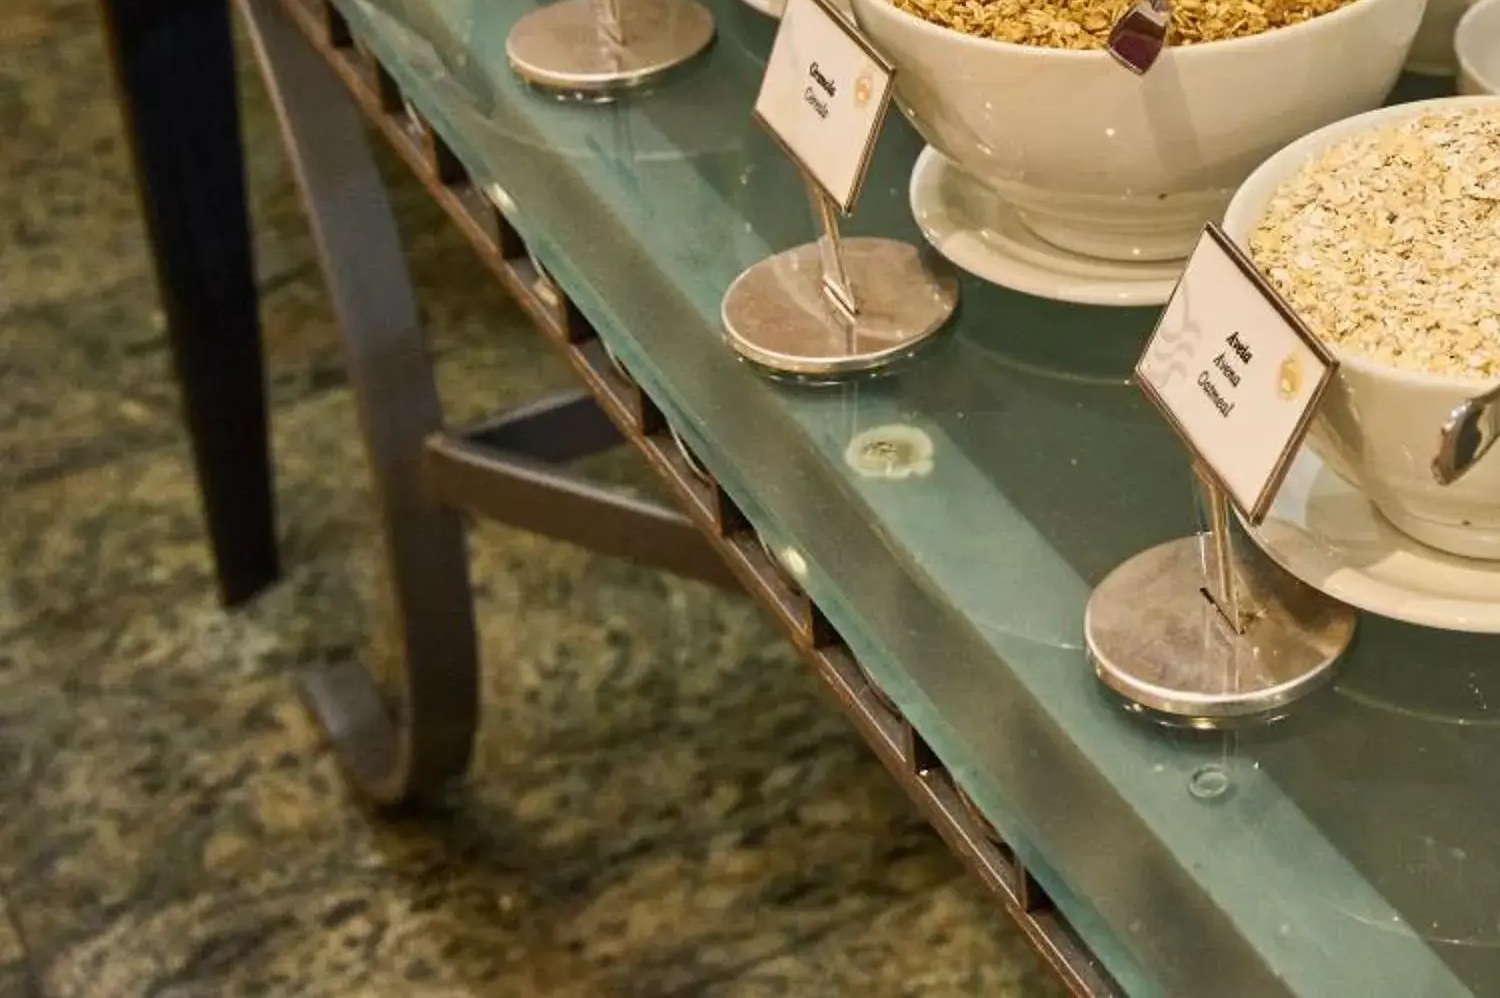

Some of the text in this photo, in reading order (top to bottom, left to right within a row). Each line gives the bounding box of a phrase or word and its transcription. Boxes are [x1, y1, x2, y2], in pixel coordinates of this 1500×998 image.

[1226, 331, 1252, 364] Aveia
[1213, 352, 1241, 387] Avena
[1197, 370, 1235, 418] Oatmeal
